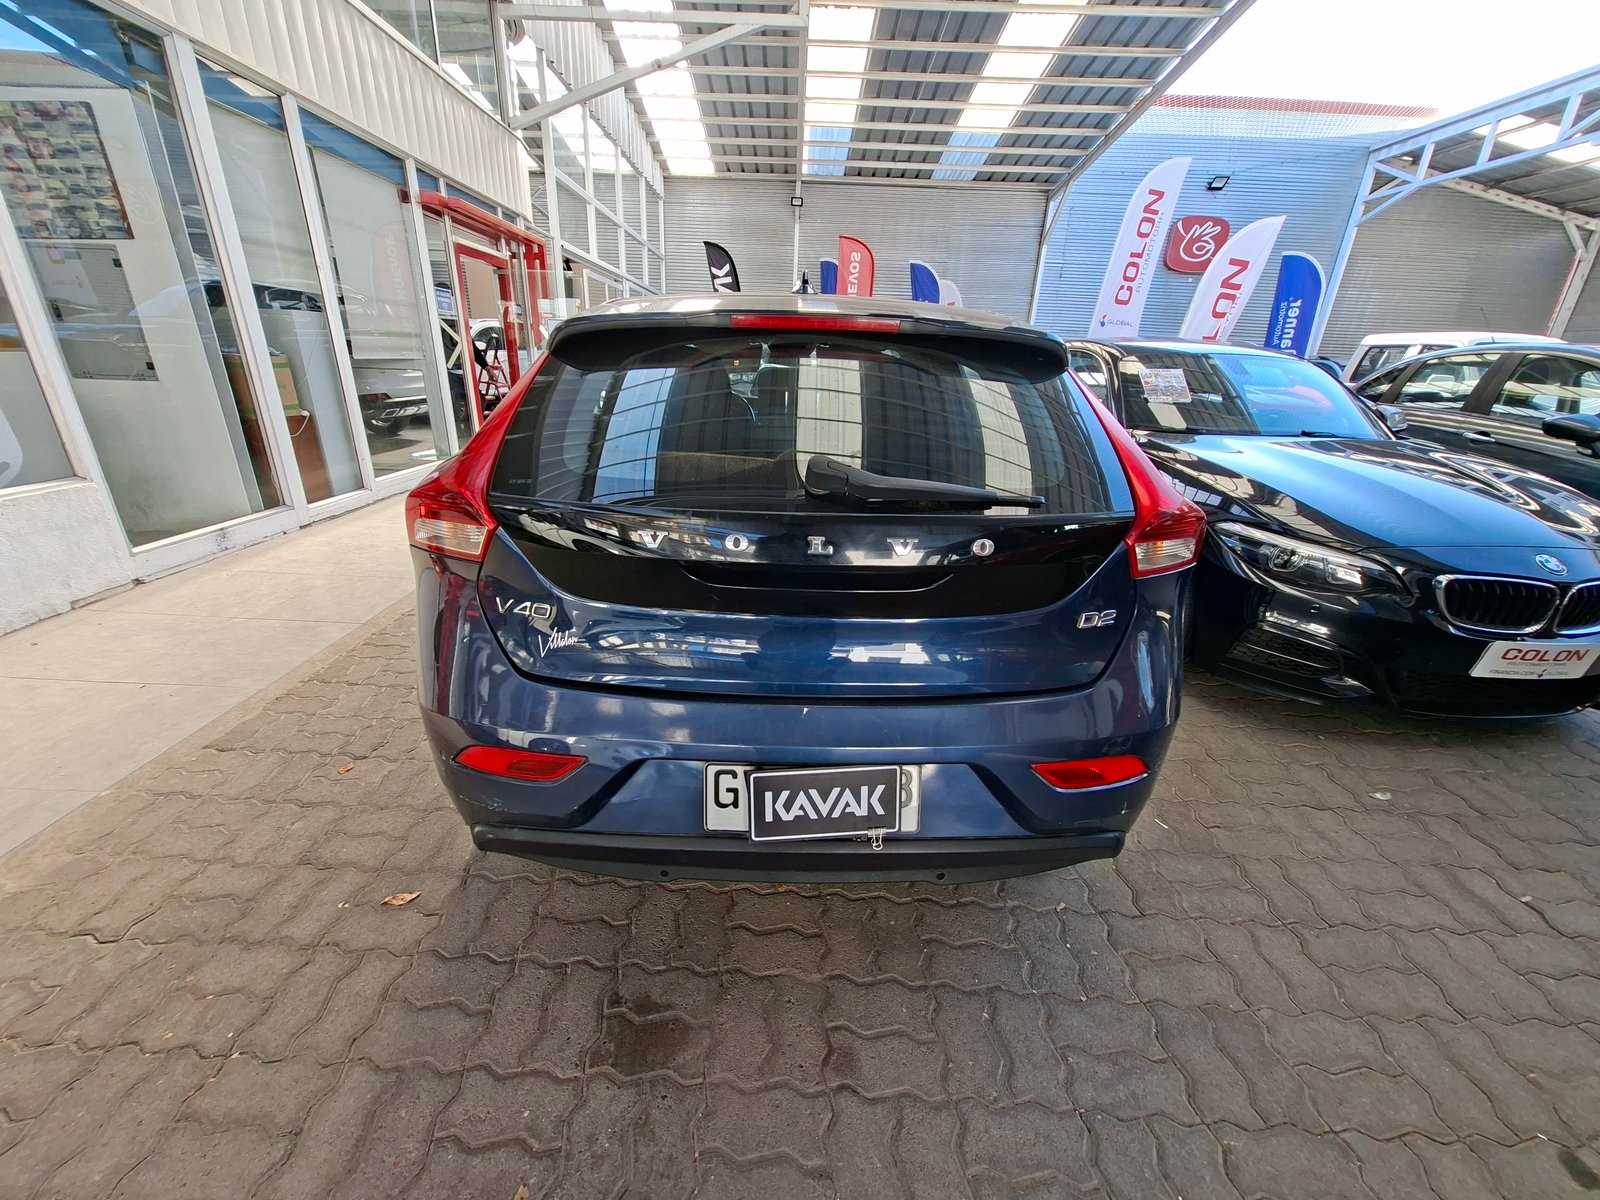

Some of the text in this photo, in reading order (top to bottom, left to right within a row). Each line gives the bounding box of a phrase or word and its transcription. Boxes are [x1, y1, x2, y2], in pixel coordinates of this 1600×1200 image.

[1114, 188, 1166, 306] COLON
[1107, 319, 1134, 328] GLOBAL
[637, 529, 995, 557] VOLVO
[495, 597, 552, 619] V40
[1077, 609, 1117, 628] D2
[1501, 648, 1591, 661] COLON
[765, 785, 886, 822] KAVAK
